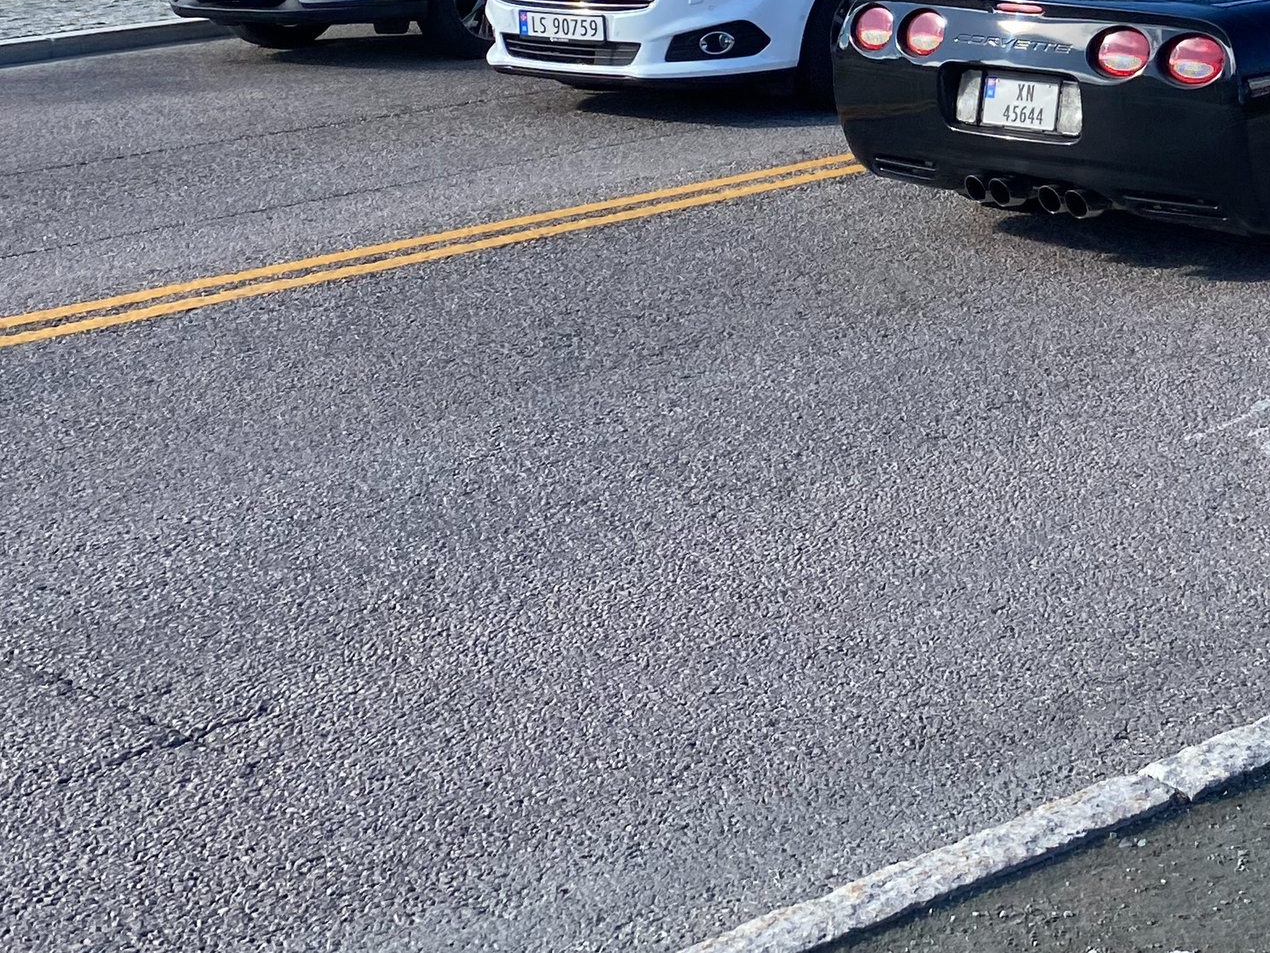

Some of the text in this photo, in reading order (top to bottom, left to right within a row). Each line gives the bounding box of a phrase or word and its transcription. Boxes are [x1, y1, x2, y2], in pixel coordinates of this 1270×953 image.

[532, 15, 598, 37] LS 90759
[1016, 83, 1036, 103] XN
[1002, 104, 1045, 125] 45644
